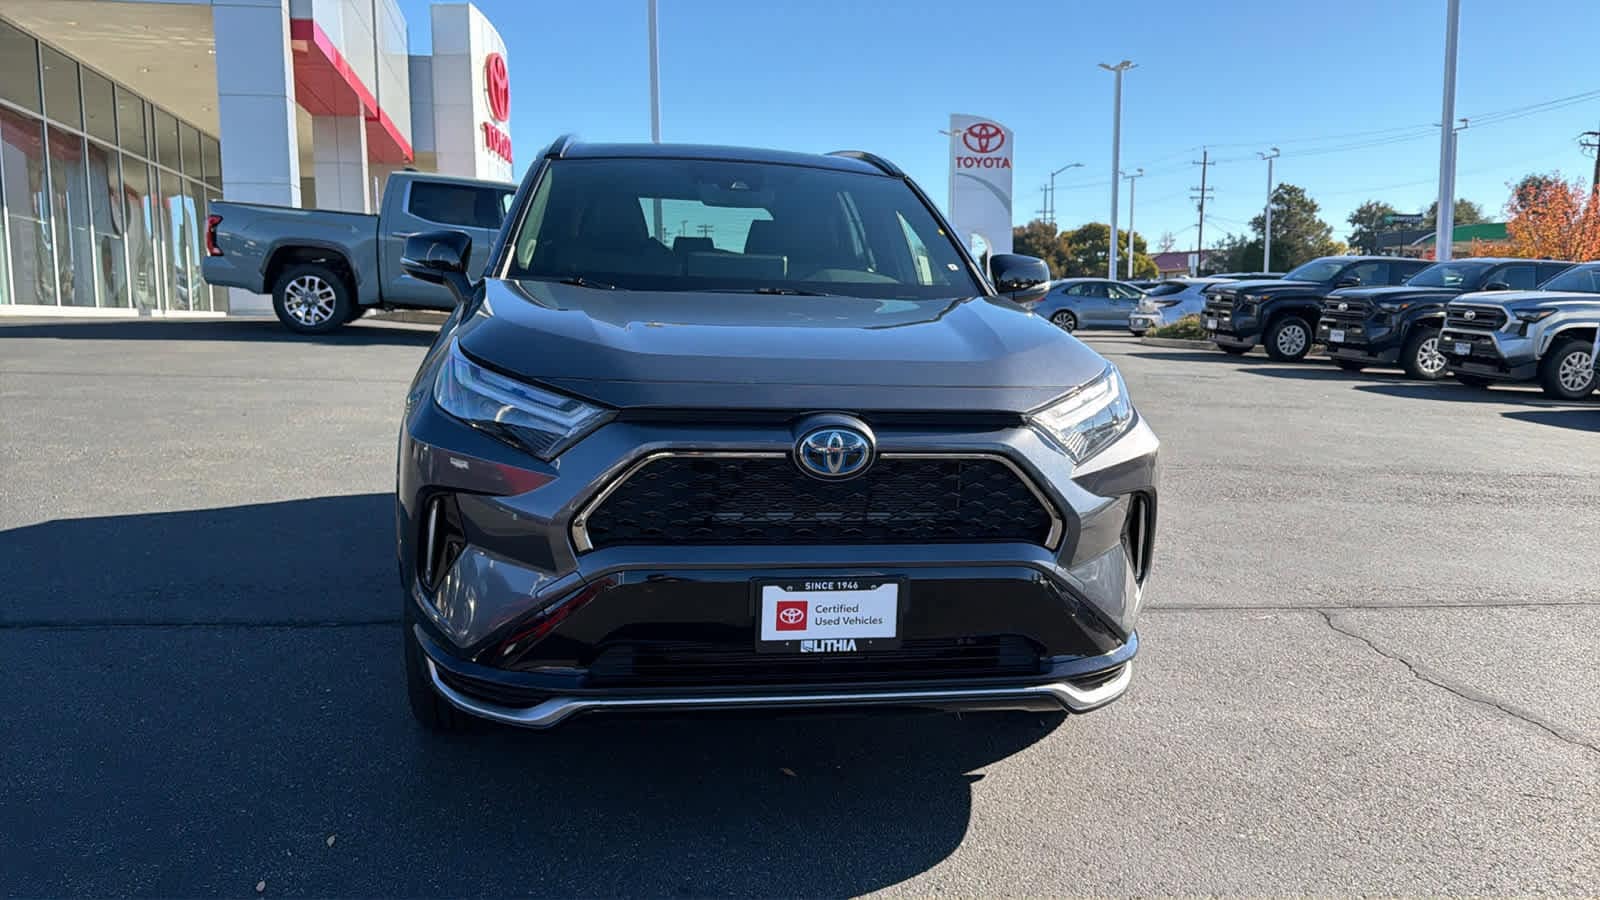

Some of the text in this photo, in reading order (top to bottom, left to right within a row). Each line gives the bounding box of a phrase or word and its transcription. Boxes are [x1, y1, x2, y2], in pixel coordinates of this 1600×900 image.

[956, 156, 1011, 169] TOYOTA
[804, 581, 858, 590] SINCE 1946
[815, 603, 860, 614] Certified
[815, 615, 884, 626] Used Vehicles
[813, 639, 857, 653] LITHIA
